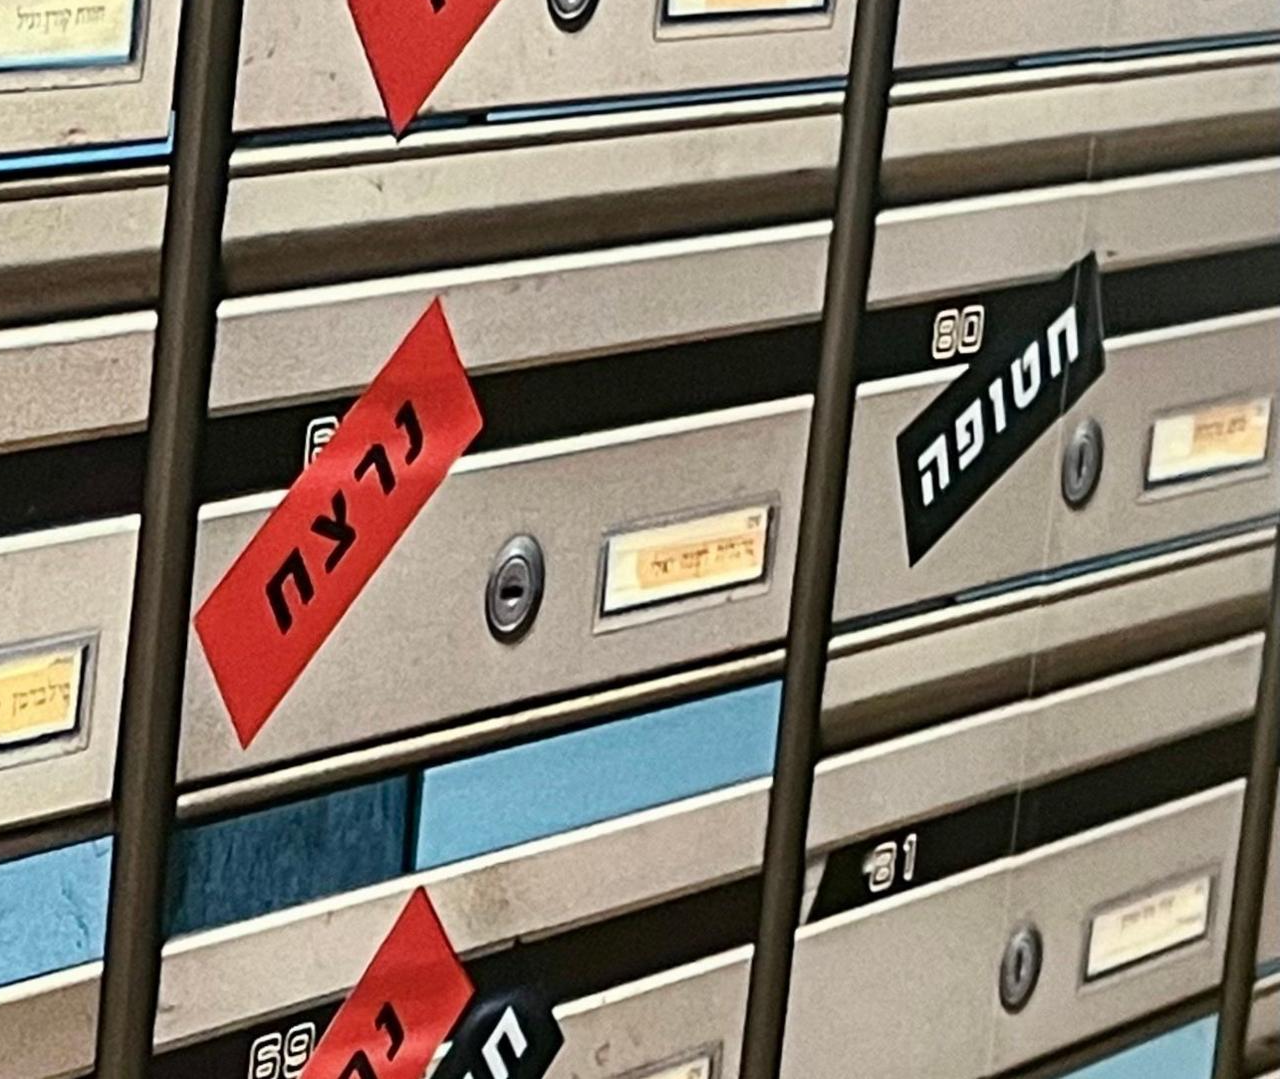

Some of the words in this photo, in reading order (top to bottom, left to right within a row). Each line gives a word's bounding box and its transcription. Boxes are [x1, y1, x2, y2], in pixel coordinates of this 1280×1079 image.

[932, 305, 984, 359] 80
[918, 304, 1079, 507] חטופה
[264, 400, 426, 636] נרצח
[868, 833, 917, 893] 81
